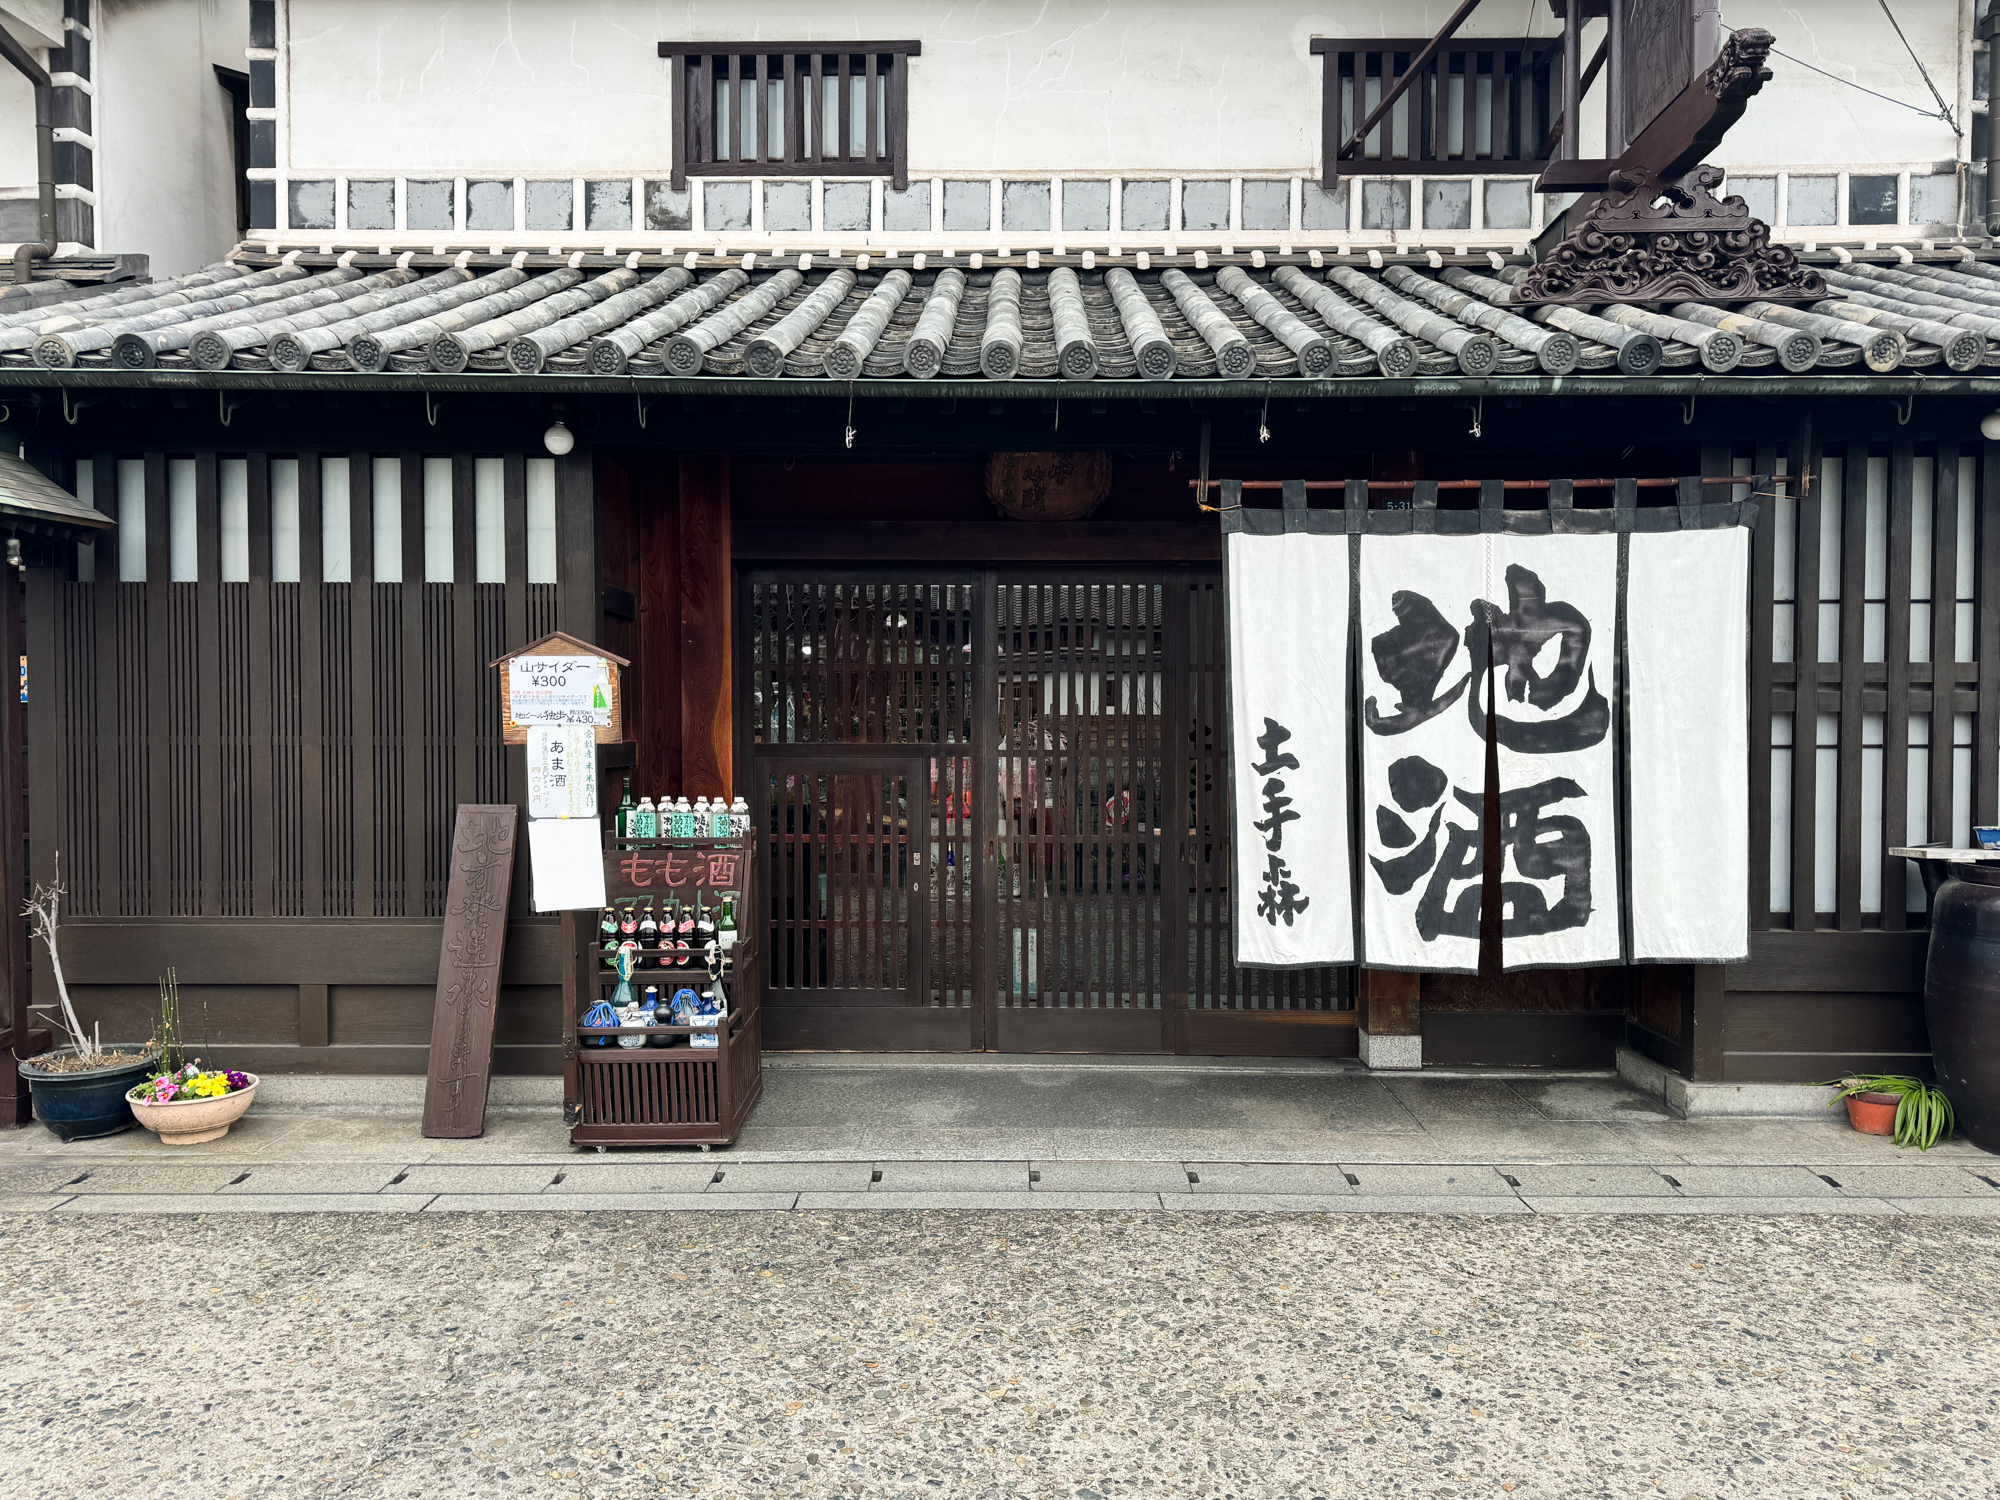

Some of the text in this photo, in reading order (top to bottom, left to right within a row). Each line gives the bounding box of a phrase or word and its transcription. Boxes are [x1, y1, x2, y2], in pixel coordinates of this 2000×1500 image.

[520, 660, 591, 673] 山サイダー
[531, 675, 567, 687] ¥300
[565, 715, 594, 724] ¥430
[550, 740, 567, 788] あま酒
[1364, 562, 1611, 943] 地酒
[531, 766, 541, 803] 四六〇円
[1250, 716, 1310, 928] 土手森
[620, 851, 740, 887] もも酒
